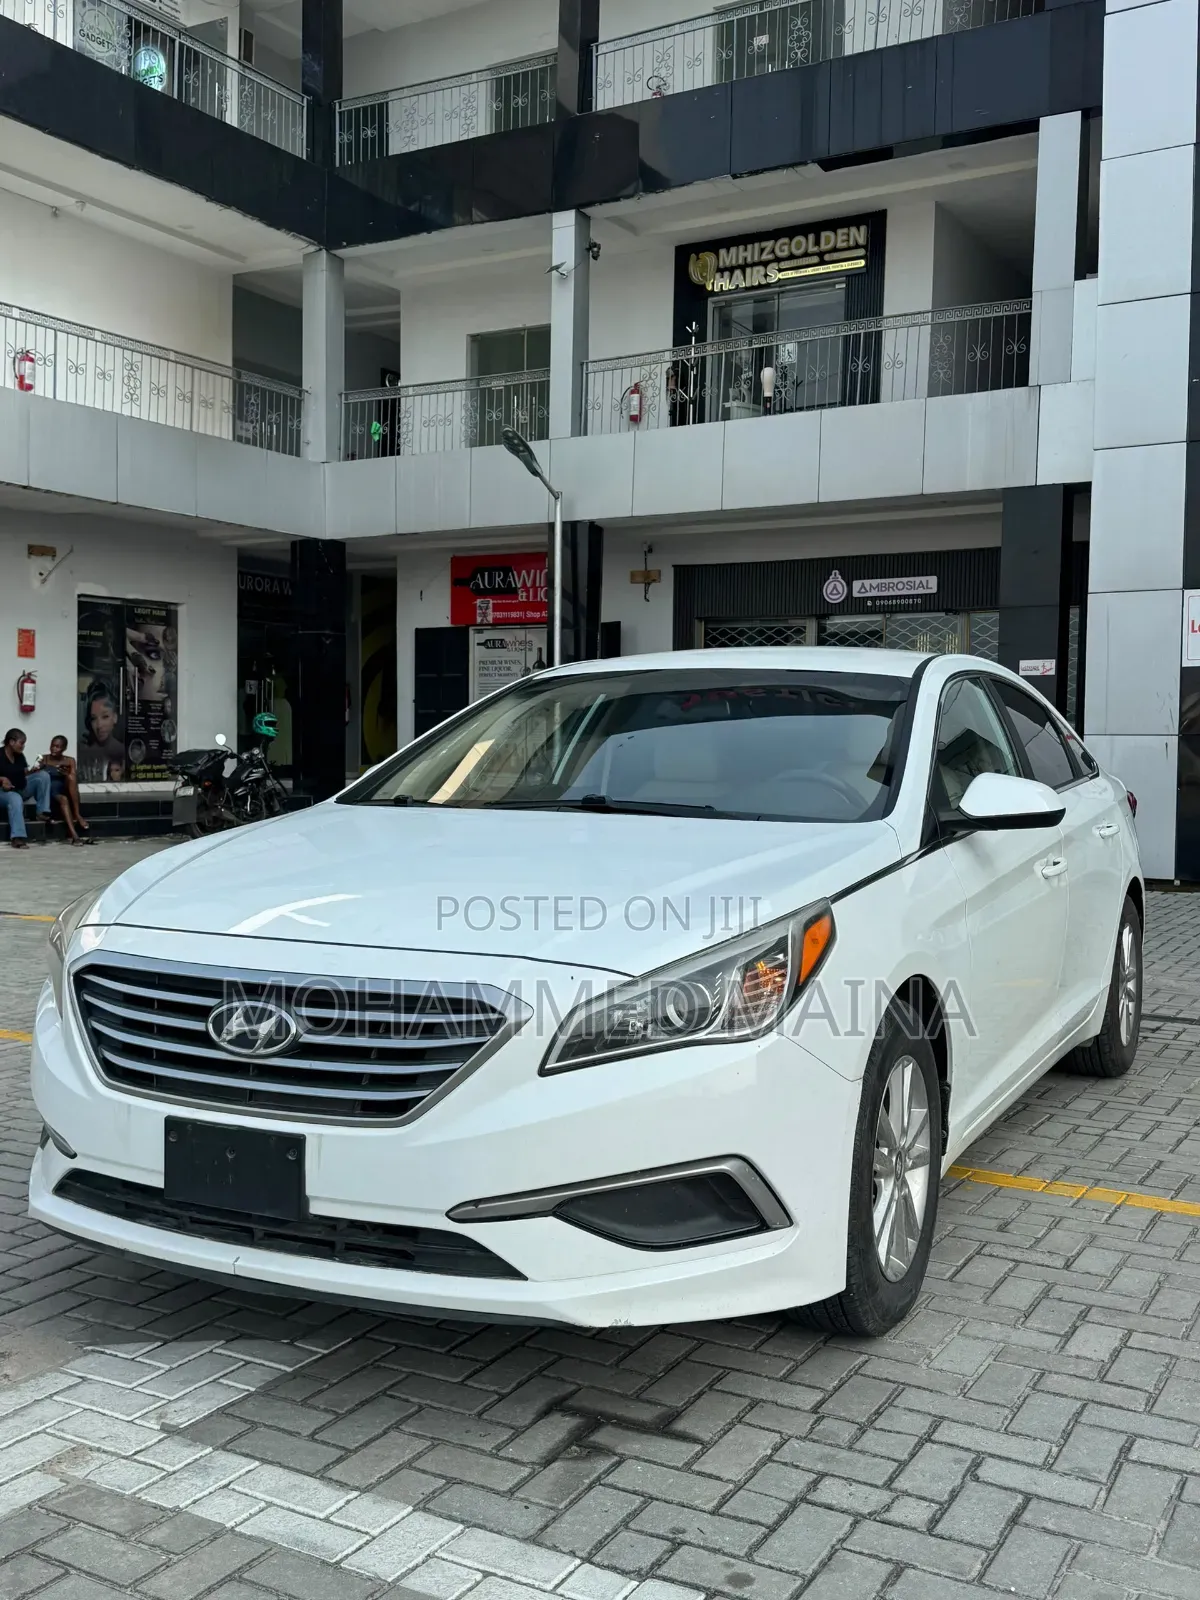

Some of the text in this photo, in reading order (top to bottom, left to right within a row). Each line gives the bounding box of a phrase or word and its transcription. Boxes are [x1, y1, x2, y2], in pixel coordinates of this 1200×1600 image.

[718, 225, 867, 269] MHIZGOLDEN
[714, 262, 779, 292] HAIRS
[470, 570, 515, 589] AURA
[857, 579, 934, 594] AMBROSIAL
[875, 598, 922, 606] 09068900870
[526, 611, 540, 619] Shop
